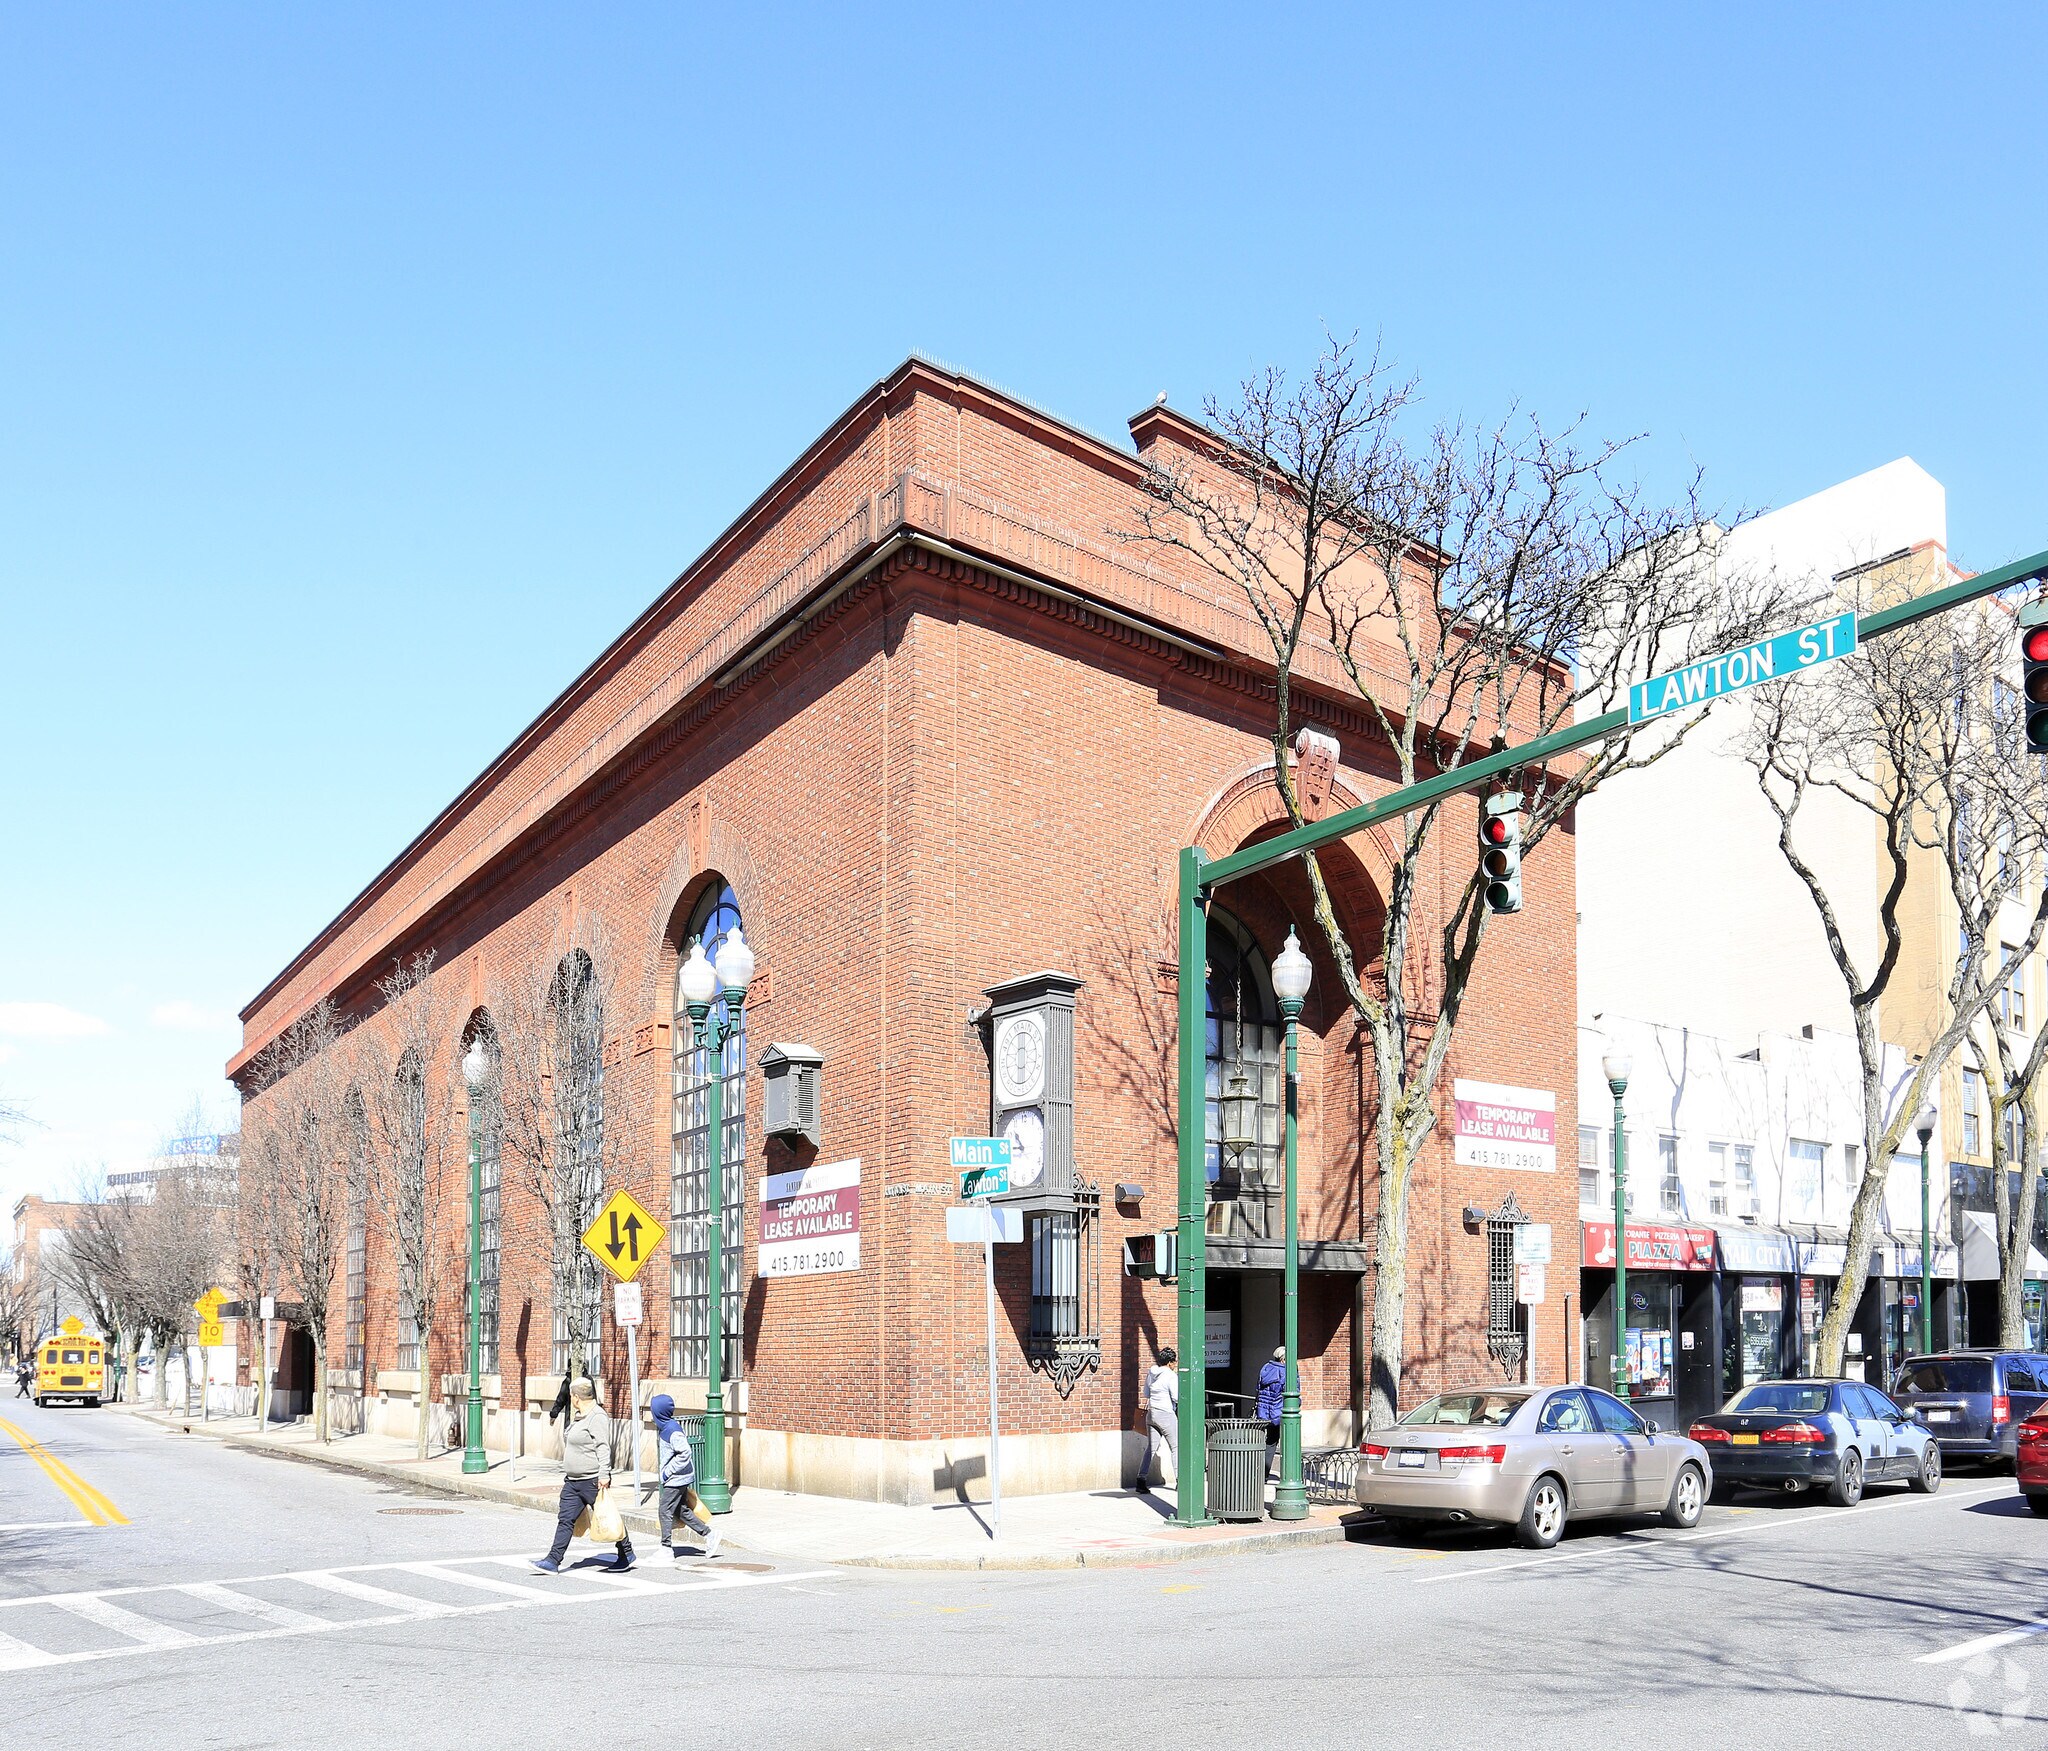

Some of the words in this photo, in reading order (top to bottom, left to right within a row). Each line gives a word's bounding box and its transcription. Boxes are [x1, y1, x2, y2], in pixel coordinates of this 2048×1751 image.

[1640, 642, 1774, 718] LAWTON
[1797, 618, 1842, 665] ST
[1013, 1022, 1033, 1034] MAIN
[1475, 1105, 1536, 1125] TEMPORARY
[1461, 1119, 1494, 1136] LEASE
[1495, 1123, 1550, 1142] AVAILABLE
[953, 1140, 993, 1163] Main
[999, 1141, 1009, 1155] St
[1470, 1150, 1542, 1168] 415.781.2900
[961, 1172, 998, 1196] Lawton
[999, 1169, 1007, 1182] St
[777, 1193, 838, 1219] TEMPORARY
[764, 1220, 794, 1240] LEASE
[795, 1211, 853, 1236] AVAILABLE
[1139, 1238, 1154, 1251] DO
[1654, 1231, 1680, 1241] PIZZERIA
[1684, 1233, 1706, 1242] BAKERY
[771, 1250, 844, 1272] 415.781.2900
[1629, 1241, 1682, 1261] PIAZZA
[1725, 1244, 1753, 1264] NAIL
[1755, 1246, 1782, 1265] CITY
[204, 1326, 219, 1337] 10
